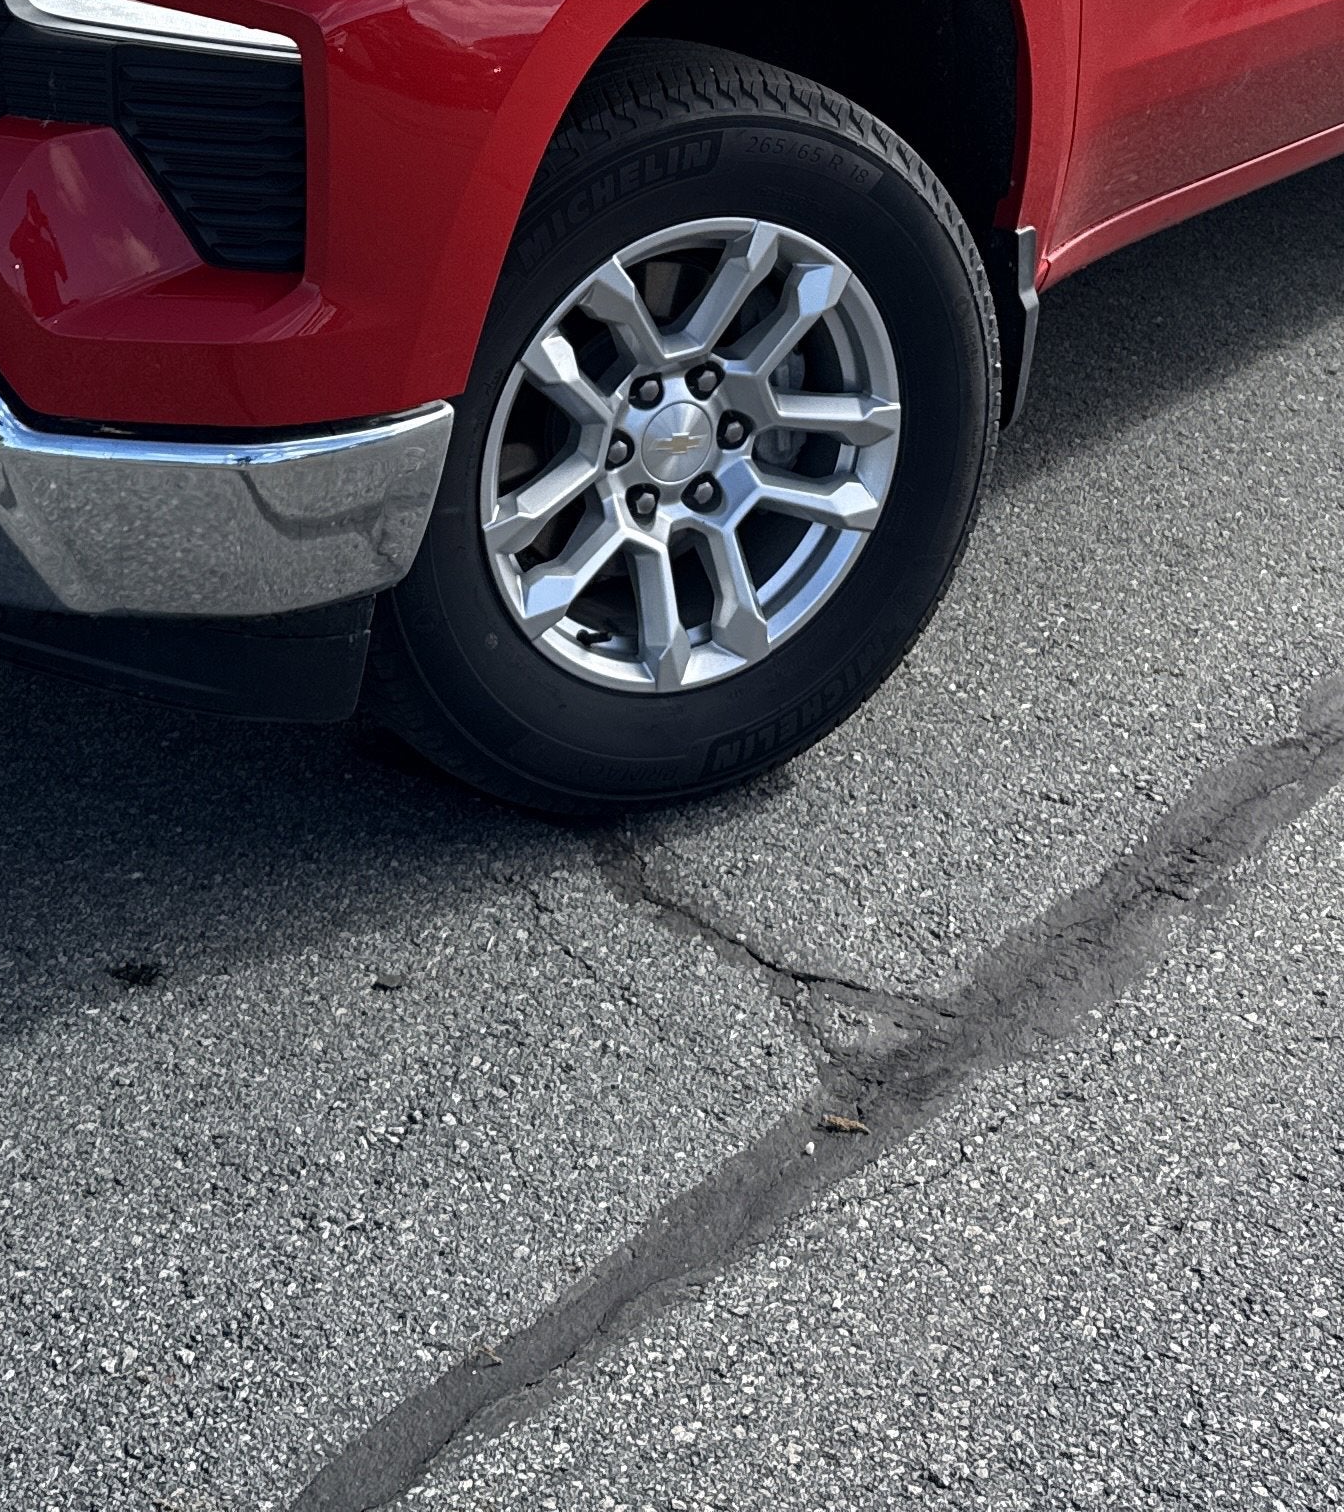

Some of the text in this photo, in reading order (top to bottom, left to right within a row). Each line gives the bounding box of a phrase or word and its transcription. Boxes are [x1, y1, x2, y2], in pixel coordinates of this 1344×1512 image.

[516, 138, 713, 274] MICHELIN
[745, 136, 871, 185] 265/65 R 18
